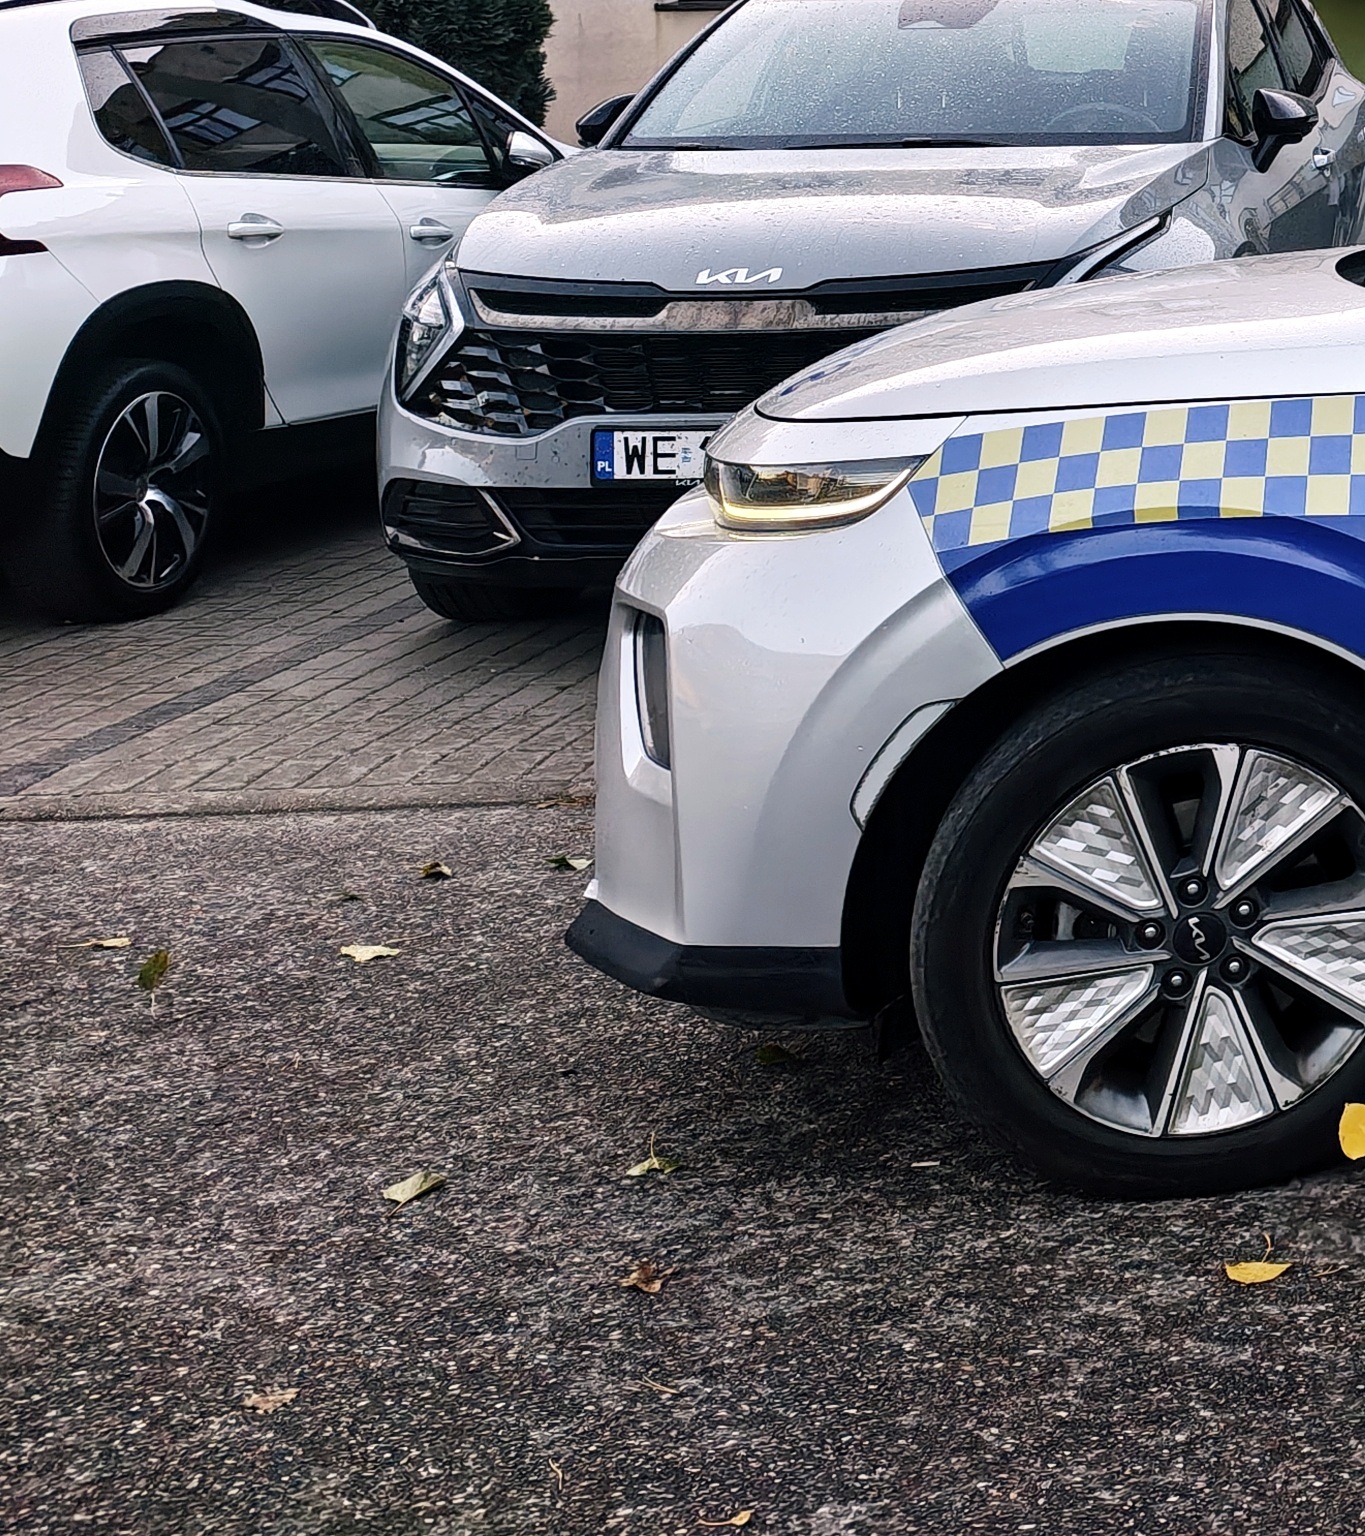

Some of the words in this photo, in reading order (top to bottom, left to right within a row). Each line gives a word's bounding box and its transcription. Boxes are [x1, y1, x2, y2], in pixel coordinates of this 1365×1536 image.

[695, 267, 783, 284] KIA
[597, 461, 612, 472] PL
[624, 436, 676, 475] WE
